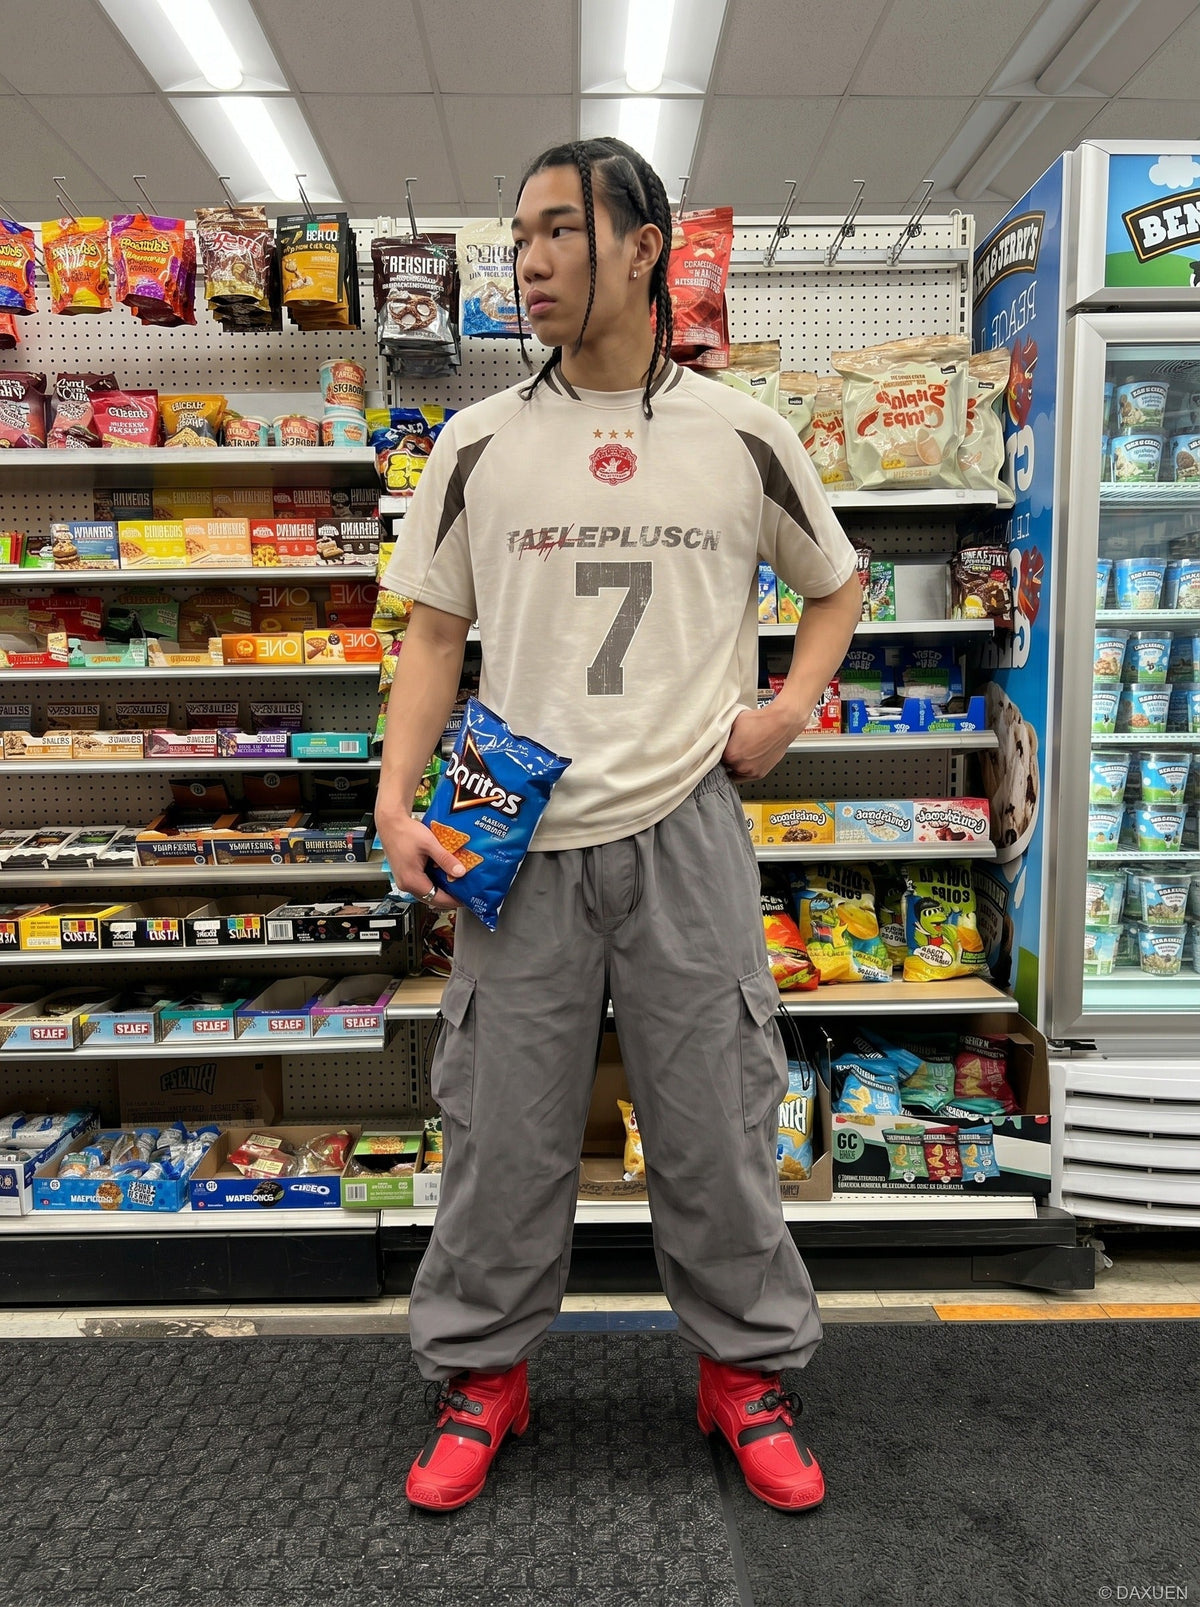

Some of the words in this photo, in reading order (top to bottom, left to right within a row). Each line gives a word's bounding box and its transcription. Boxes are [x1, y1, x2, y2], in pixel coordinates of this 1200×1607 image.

[998, 222, 1039, 271] JERRY'S
[574, 561, 653, 696] 7
[446, 752, 523, 816] Doritos
[836, 1133, 858, 1150] GC
